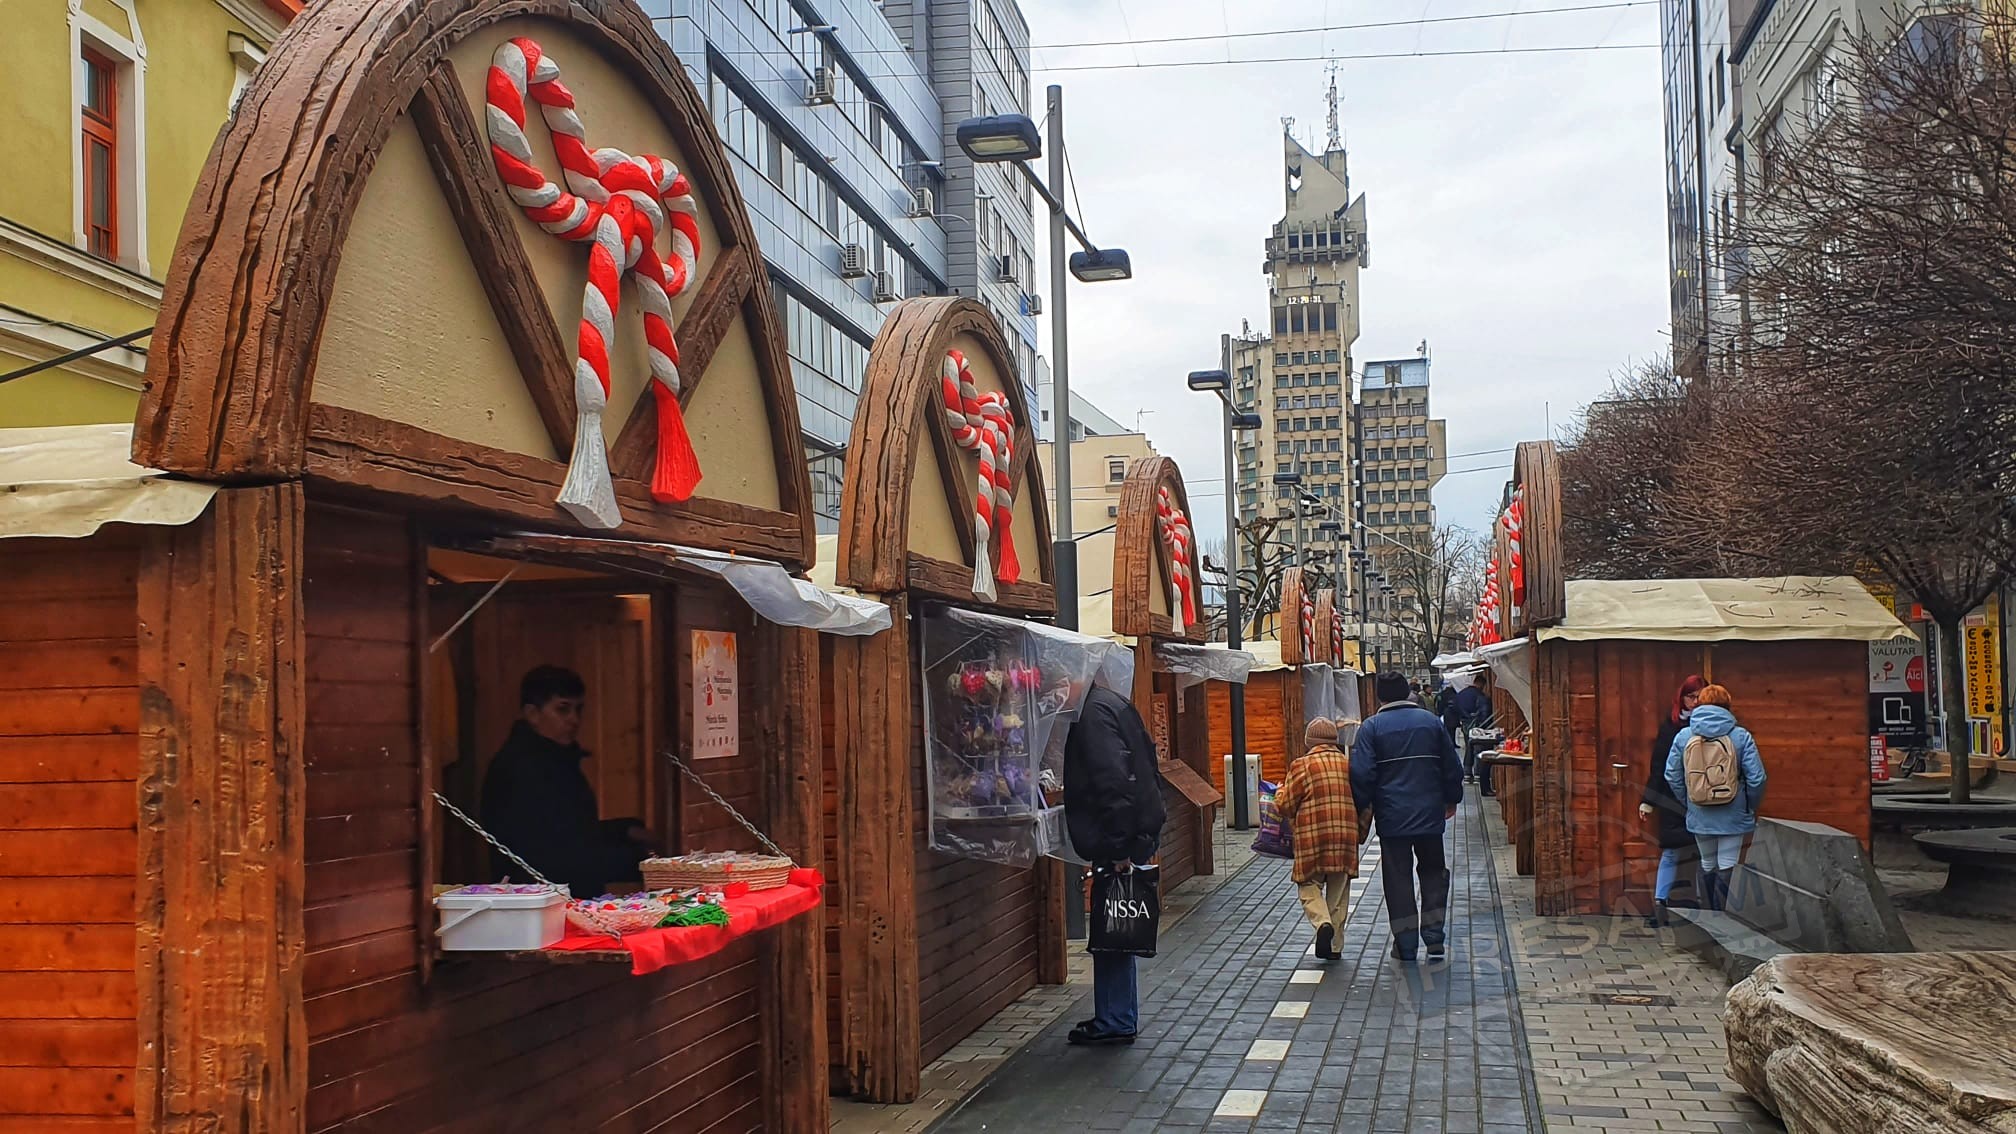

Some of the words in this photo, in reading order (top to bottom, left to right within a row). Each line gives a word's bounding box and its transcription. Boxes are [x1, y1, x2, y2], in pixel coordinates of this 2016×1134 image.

[1871, 637, 1916, 647] SCHIMB
[1871, 647, 1916, 656] VALUTAR
[1104, 899, 1150, 919] NISSA
